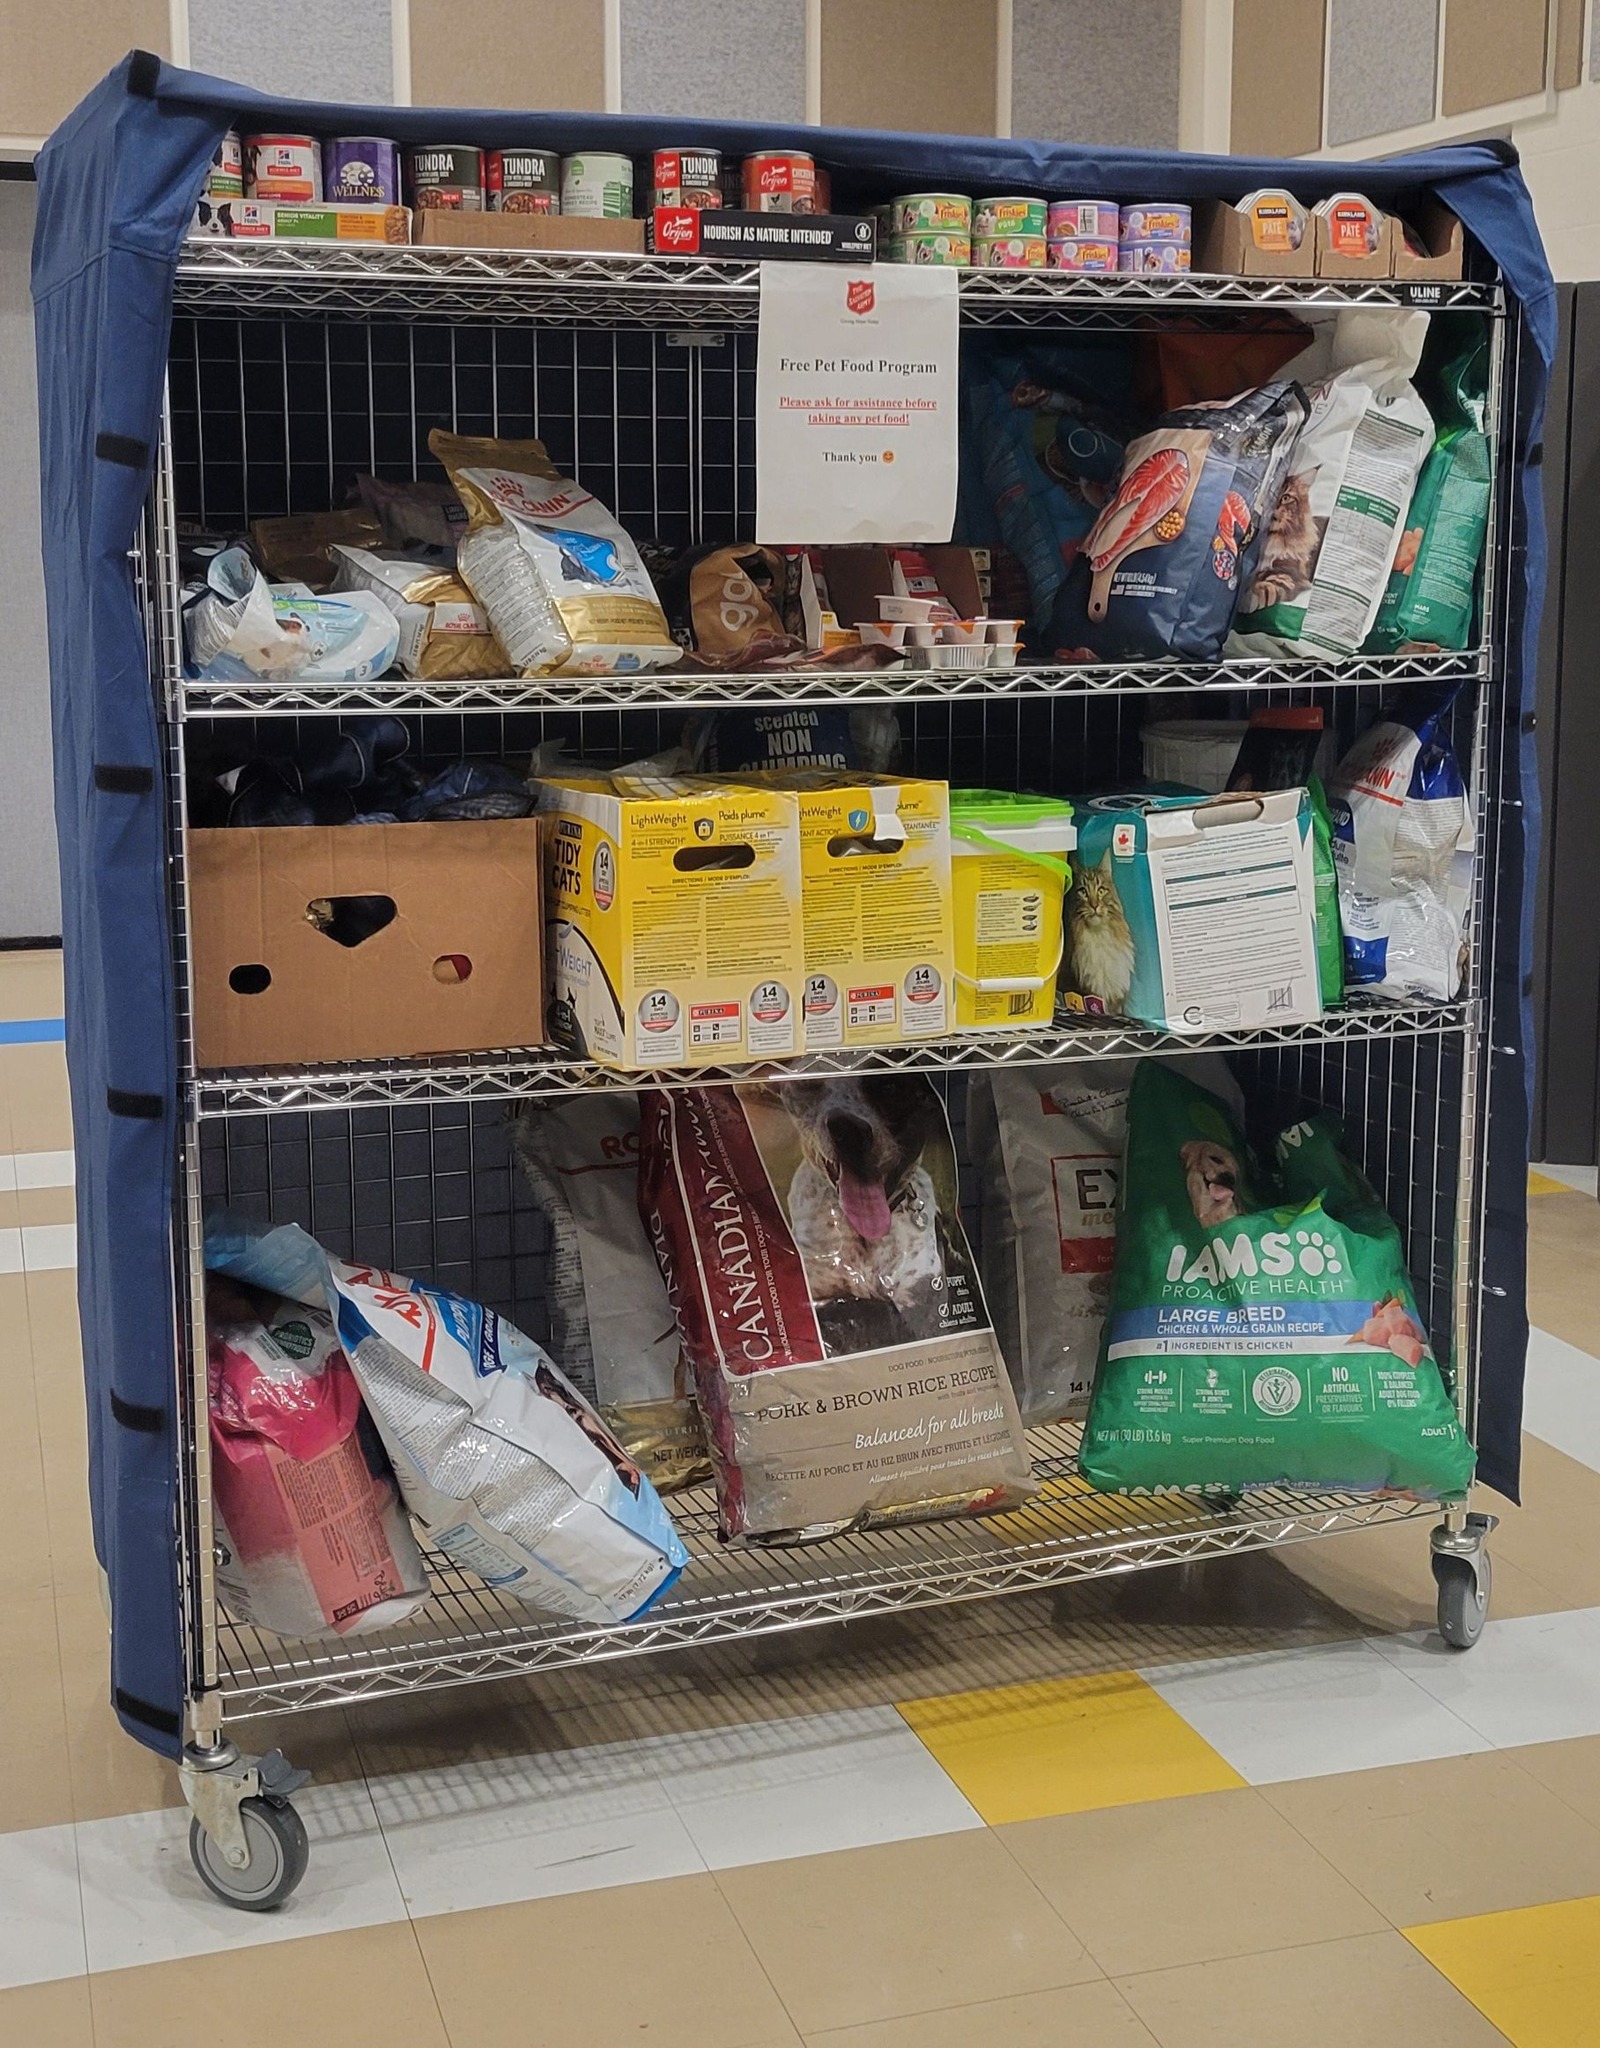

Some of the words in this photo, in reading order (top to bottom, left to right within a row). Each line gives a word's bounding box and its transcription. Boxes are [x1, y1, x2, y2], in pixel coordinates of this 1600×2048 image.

[414, 154, 454, 172] TUNDRA
[502, 157, 546, 177] TUNDRA
[680, 156, 718, 176] TUNDRA
[761, 171, 788, 191] Orijen
[332, 185, 385, 198] WELLNESS
[662, 221, 693, 245] Orijen
[703, 224, 741, 241] NOURISH
[743, 226, 755, 242] AS
[756, 227, 789, 244] NATURE
[791, 228, 832, 245] INTENDED
[1410, 286, 1441, 299] ULINE
[779, 358, 811, 372] Free
[814, 358, 836, 372] Pet
[840, 359, 874, 373] Food
[878, 360, 938, 376] Program
[779, 397, 812, 408] Please
[814, 397, 832, 408] ask
[835, 397, 850, 408] for
[853, 398, 903, 408] assistance
[904, 398, 937, 409] before
[808, 413, 842, 424] taking
[844, 415, 862, 425] any
[865, 414, 881, 425] pet
[883, 413, 910, 424] food!
[822, 452, 857, 462] Thank
[858, 453, 878, 464] you
[522, 494, 572, 513] CANIN
[754, 710, 820, 733] scented
[767, 728, 813, 756] NON
[630, 813, 687, 829] LightWeight
[718, 809, 740, 821] Poids
[740, 809, 766, 823] plume
[719, 832, 754, 842] PUISSANCE
[815, 828, 838, 836] ACTION
[649, 836, 685, 846] STRENGTH
[554, 838, 582, 868] TIDY
[600, 851, 609, 870] 14
[829, 866, 859, 874] DIRECTIONS
[862, 864, 878, 872] MODE
[551, 865, 581, 896] CATS
[672, 877, 704, 885] DIRECTIONS
[707, 875, 724, 883] MODE
[915, 969, 930, 981] 14
[762, 986, 778, 998] 14
[811, 979, 826, 991] 14
[650, 995, 667, 1008] 14
[700, 1166, 774, 1361] CANADIAN
[1166, 1232, 1295, 1287] IAMS
[946, 1275, 967, 1288] PUPPY
[769, 1286, 781, 1309] FOOD
[1162, 1279, 1265, 1302] PROACTIVE
[1269, 1279, 1345, 1296] HEALTH
[952, 1301, 975, 1316] ADULT
[1158, 1308, 1221, 1324] LARGE
[1225, 1305, 1287, 1324] BREED
[1156, 1323, 1200, 1335] CHICKEN
[1201, 1324, 1209, 1334] &
[1211, 1323, 1250, 1335] WHOLE
[1251, 1323, 1285, 1334] GRAIN
[1287, 1322, 1325, 1334] RECIPE
[274, 1330, 314, 1347] PROBIOTICS
[1156, 1339, 1169, 1353] #1
[1171, 1341, 1231, 1351] INGREDIENT
[1234, 1341, 1243, 1351] IS
[1251, 1340, 1294, 1351] CHICKEN
[888, 1363, 905, 1374] DOG
[905, 1359, 924, 1370] FOOD
[1331, 1366, 1349, 1382] NO
[1377, 1371, 1392, 1380] 100%
[757, 1401, 811, 1423] PORK
[816, 1398, 828, 1415] &
[832, 1384, 904, 1412] BROWN
[908, 1375, 948, 1398] RICE
[949, 1365, 997, 1389] RECIPE
[1069, 1381, 1084, 1393] 14
[1322, 1384, 1360, 1394] ARTIFICIAL
[1378, 1390, 1396, 1399] ADULT
[1395, 1390, 1408, 1399] DOG
[1407, 1390, 1421, 1399] FOOD
[1322, 1404, 1331, 1413] OR
[1331, 1404, 1364, 1413] FLAVOURS
[854, 1417, 927, 1450] Balanced
[925, 1416, 947, 1446] for
[949, 1410, 970, 1432] all
[970, 1405, 1005, 1427] breeds
[1421, 1427, 1447, 1437] ADULT
[1096, 1430, 1109, 1442] NET
[1109, 1430, 1120, 1442] WT
[1120, 1429, 1132, 1443] (30
[1132, 1429, 1145, 1443] LB)
[1145, 1429, 1161, 1442] 13.6
[1160, 1430, 1172, 1445] kg
[1182, 1436, 1204, 1445] Super
[1205, 1435, 1238, 1444] Premium
[1238, 1436, 1255, 1445] Dog
[1255, 1436, 1275, 1444] Food
[653, 1449, 673, 1462] NET
[765, 1469, 807, 1483] RECETTE
[808, 1467, 823, 1480] AU
[823, 1464, 851, 1478] PORC
[852, 1461, 865, 1473] ET
[865, 1458, 880, 1471] AU
[880, 1456, 896, 1468] RIZ
[896, 1452, 920, 1465] BRUN
[921, 1446, 943, 1461] AVEC
[943, 1439, 972, 1454] FRUITS
[972, 1437, 982, 1448] ET
[869, 1471, 899, 1485] Aliment
[929, 1460, 947, 1475] pour
